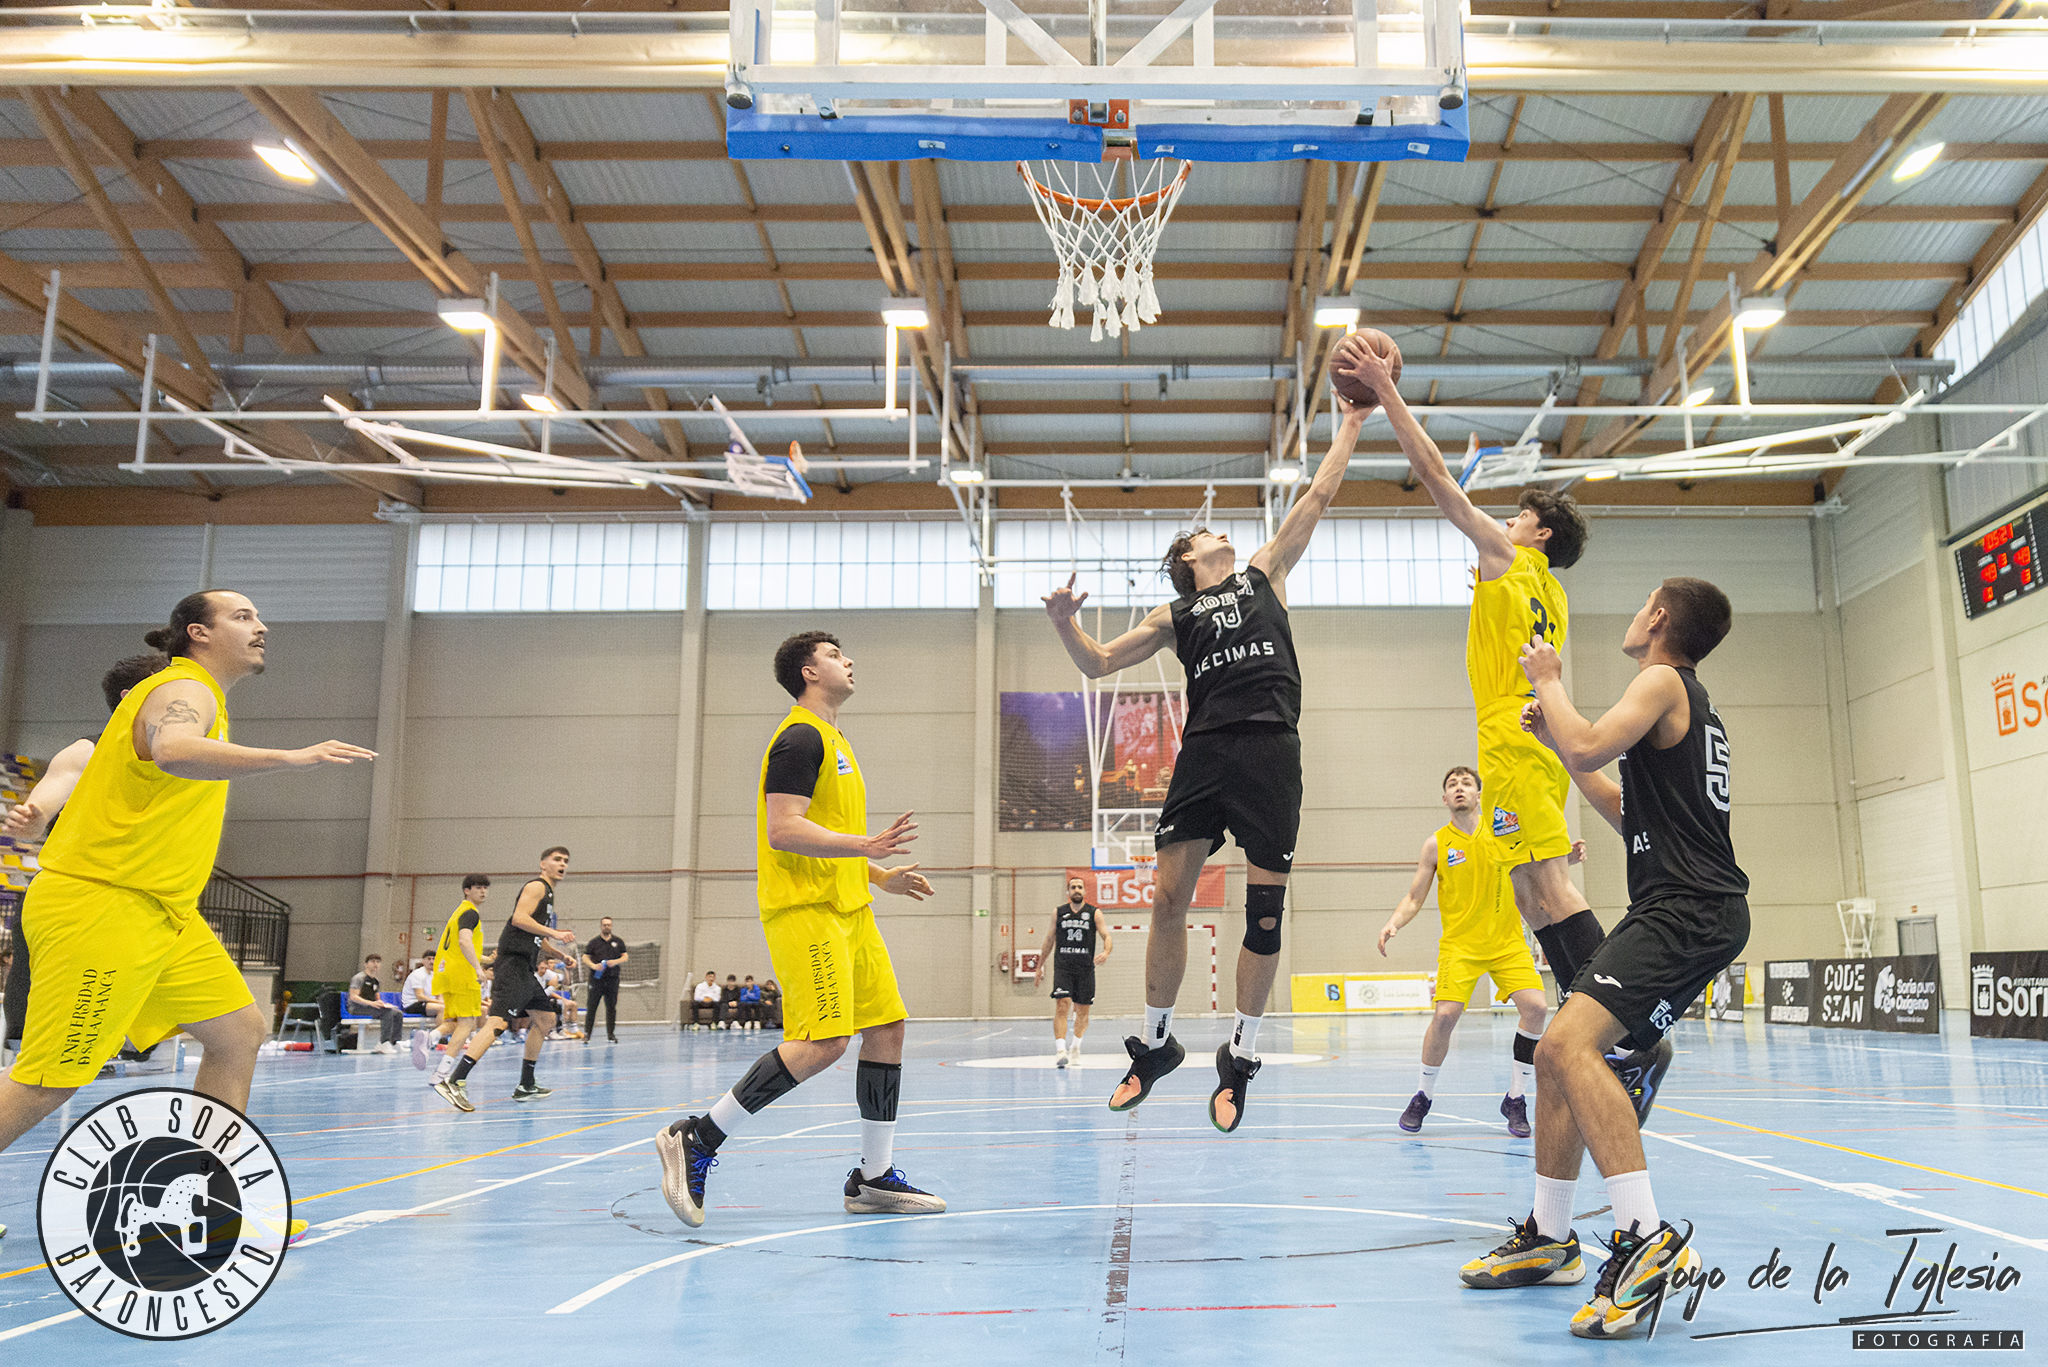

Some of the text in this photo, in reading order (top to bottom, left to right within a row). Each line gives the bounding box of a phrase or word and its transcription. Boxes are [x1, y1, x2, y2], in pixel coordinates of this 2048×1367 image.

[2022, 681, 2048, 727] S
[1067, 929, 1083, 941] 14
[1824, 964, 1865, 992] CODE
[1896, 978, 1917, 995] Soria
